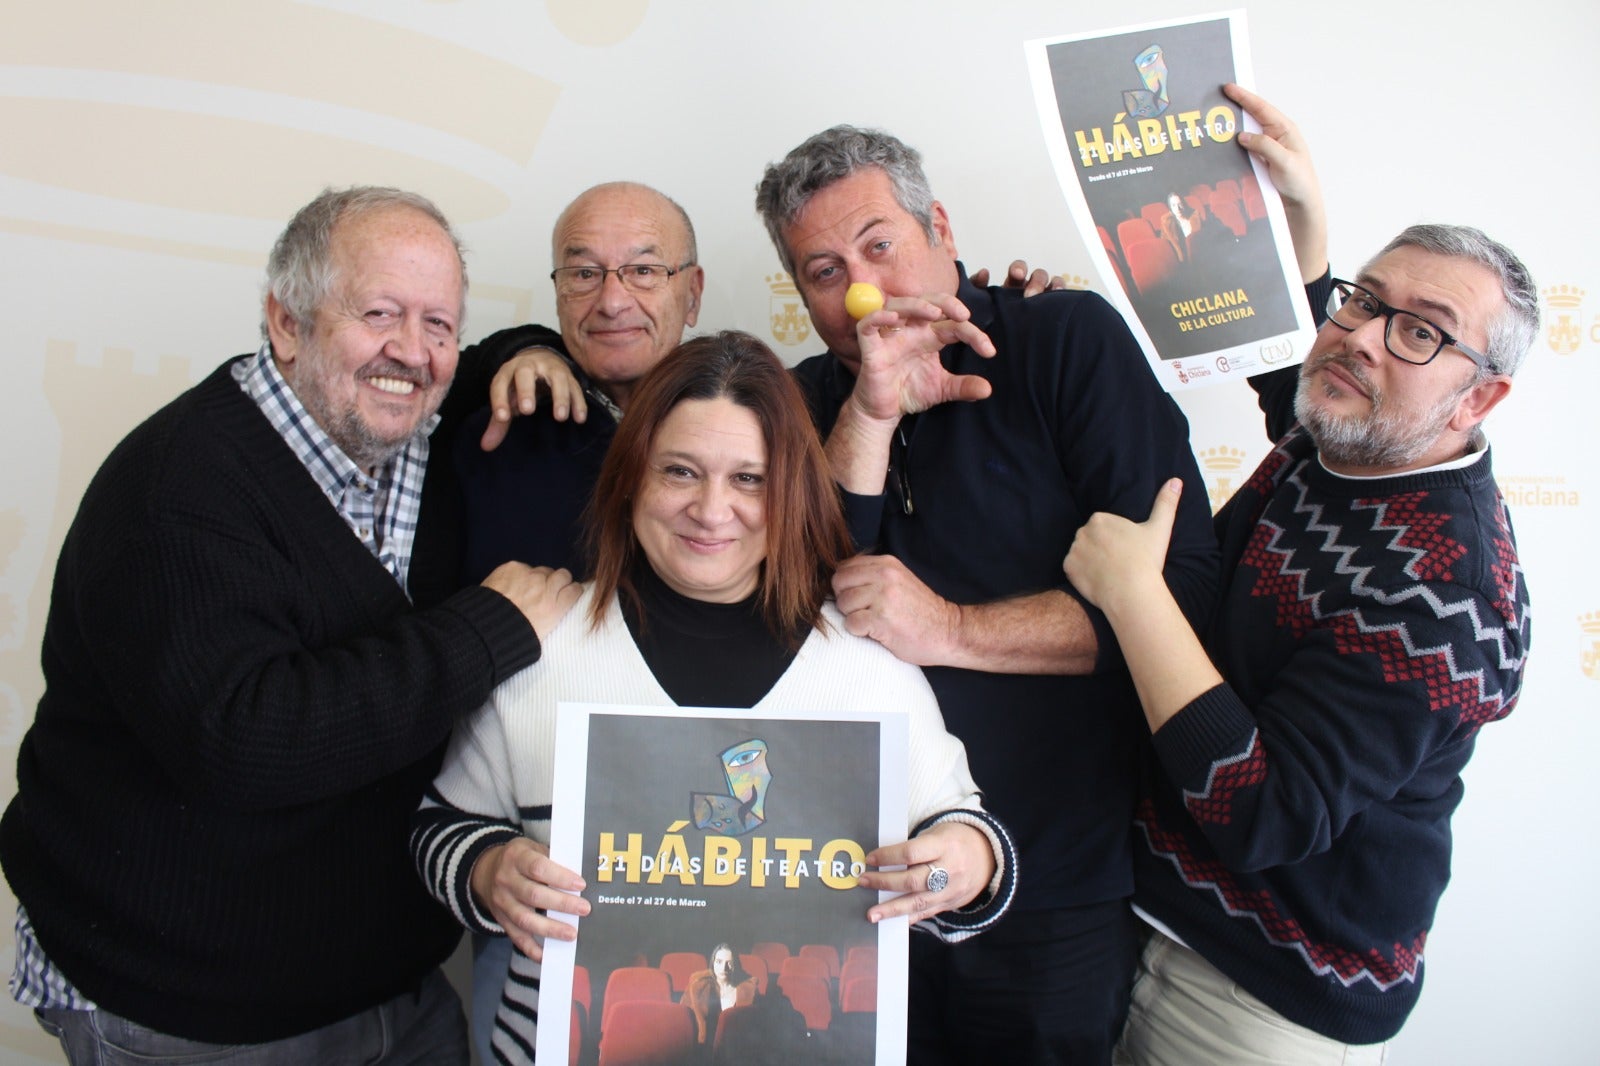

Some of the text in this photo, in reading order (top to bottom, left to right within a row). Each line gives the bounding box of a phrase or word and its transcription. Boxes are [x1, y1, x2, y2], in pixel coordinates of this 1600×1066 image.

[1074, 105, 1236, 167] HÁBITO
[1078, 120, 1236, 160] 21 DÍAS DE TEATRO
[1088, 174, 1106, 182] Desde
[1170, 288, 1248, 319] CHICLANA
[1179, 306, 1255, 332] DE LA CULTURA
[1502, 484, 1580, 506] hiclana
[597, 820, 866, 890] HÁBITO
[597, 852, 866, 878] 21 DÍAS DE TEATRO
[598, 895, 707, 907] Desde el 7 al 27 de Marzo
